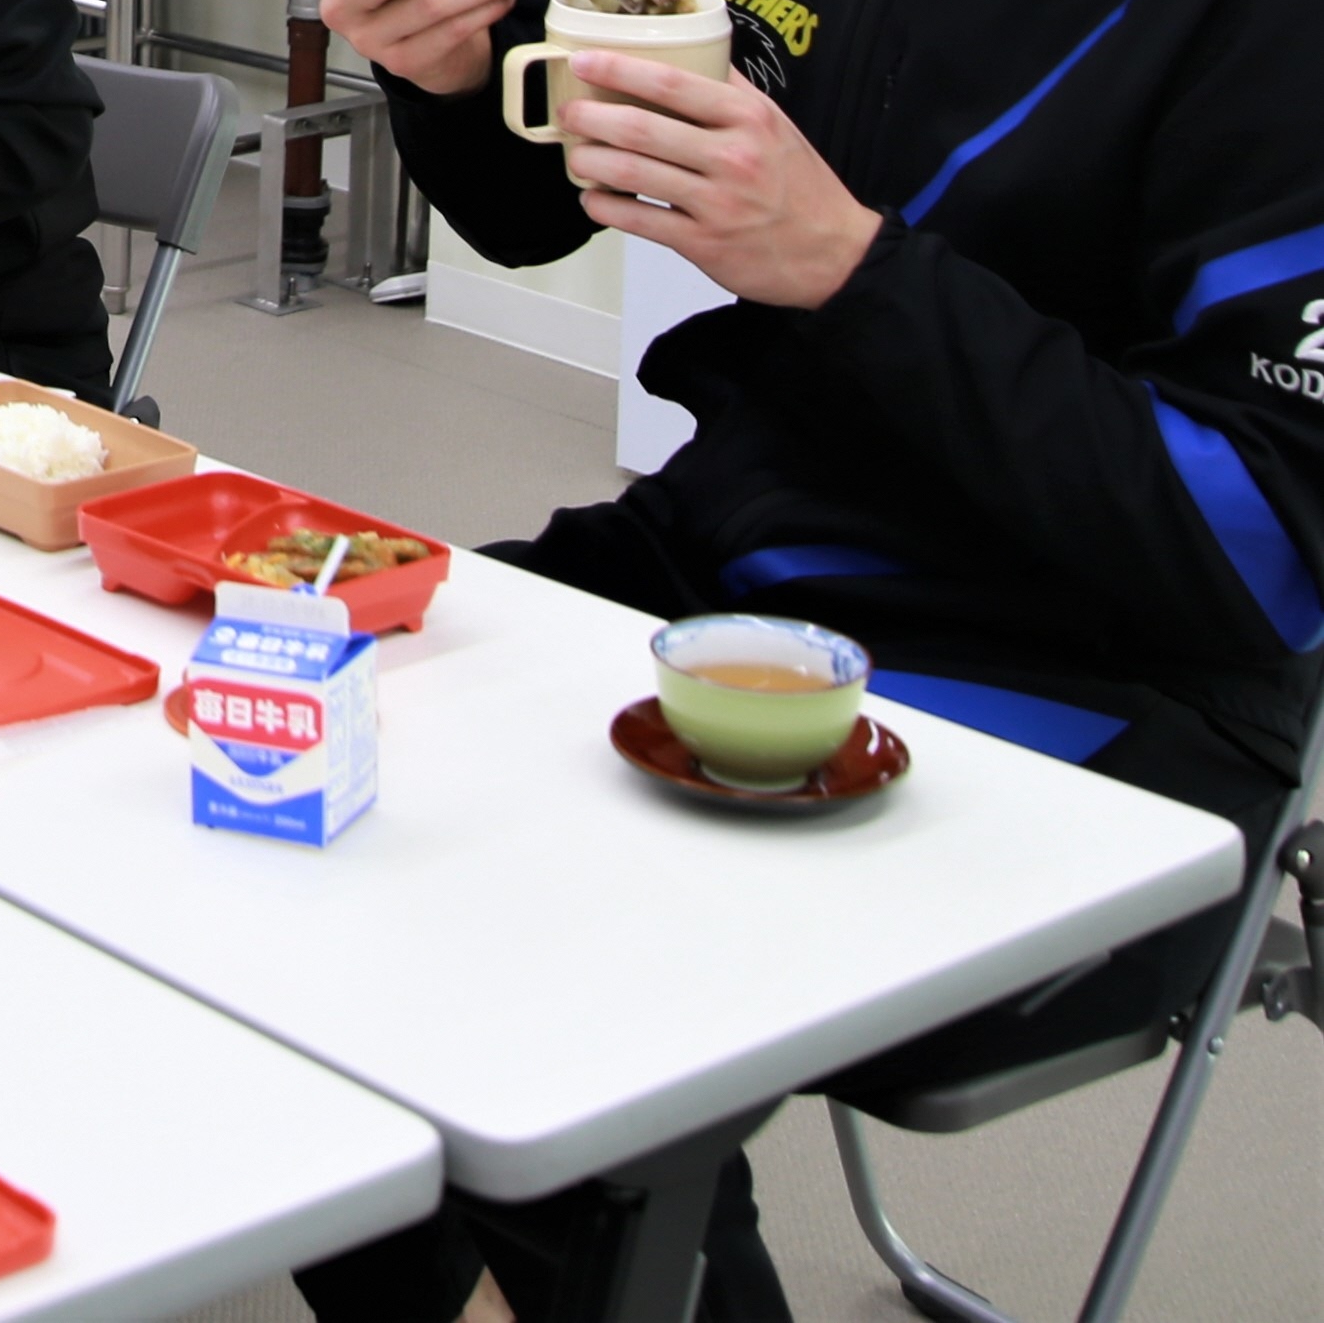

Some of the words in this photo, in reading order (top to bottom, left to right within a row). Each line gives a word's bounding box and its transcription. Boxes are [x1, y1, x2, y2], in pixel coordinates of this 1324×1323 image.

[1250, 352, 1324, 405] KOD
[193, 688, 319, 740] 毎日牛乳
